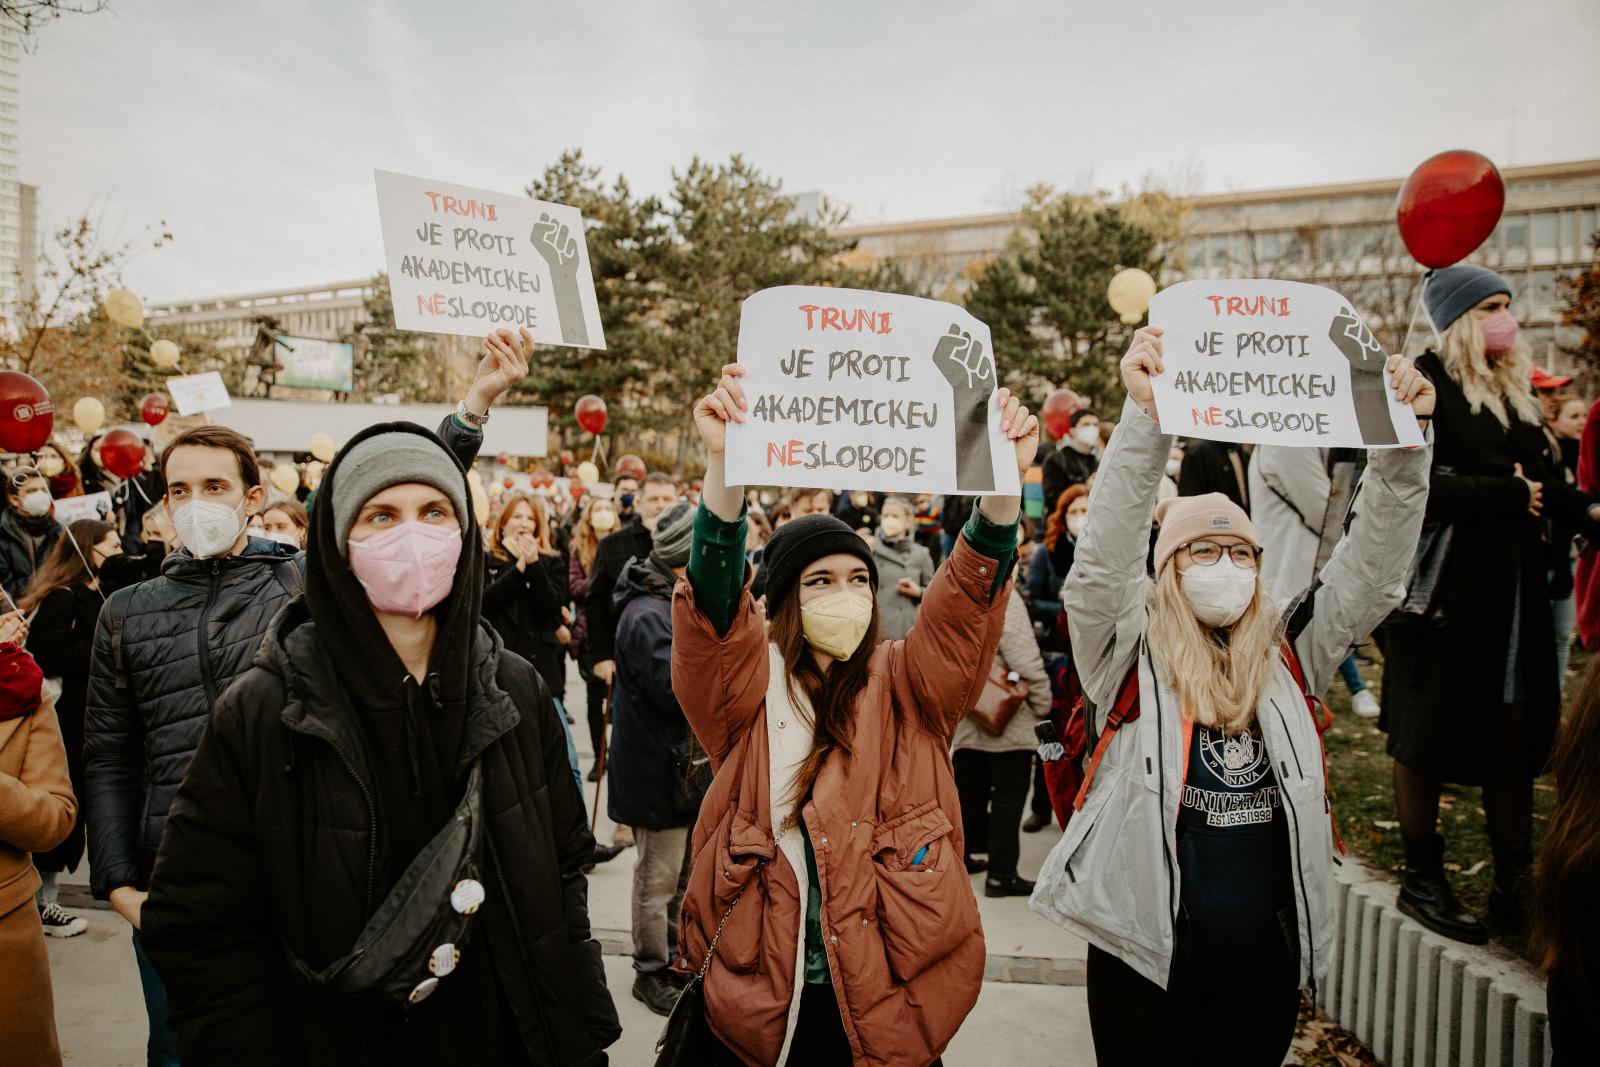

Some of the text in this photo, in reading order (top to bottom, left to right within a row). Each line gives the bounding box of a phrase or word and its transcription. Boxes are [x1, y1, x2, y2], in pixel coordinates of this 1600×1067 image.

[425, 192, 497, 221] TRUNI
[416, 222, 516, 256] JE PROTI
[400, 255, 540, 293] AKADEMICKEJ
[417, 293, 538, 328] NESLOBODE
[799, 304, 893, 334] TRUNI
[1206, 295, 1290, 317] TRUNI
[1195, 331, 1310, 359] JE PROTI
[780, 348, 910, 382] JE PROTI
[1174, 370, 1335, 399] AKADEMICKEJ
[753, 394, 937, 430] AKADEMICKEJ
[1192, 407, 1330, 434] NESLOBODE
[767, 439, 926, 476] NESLOBODE
